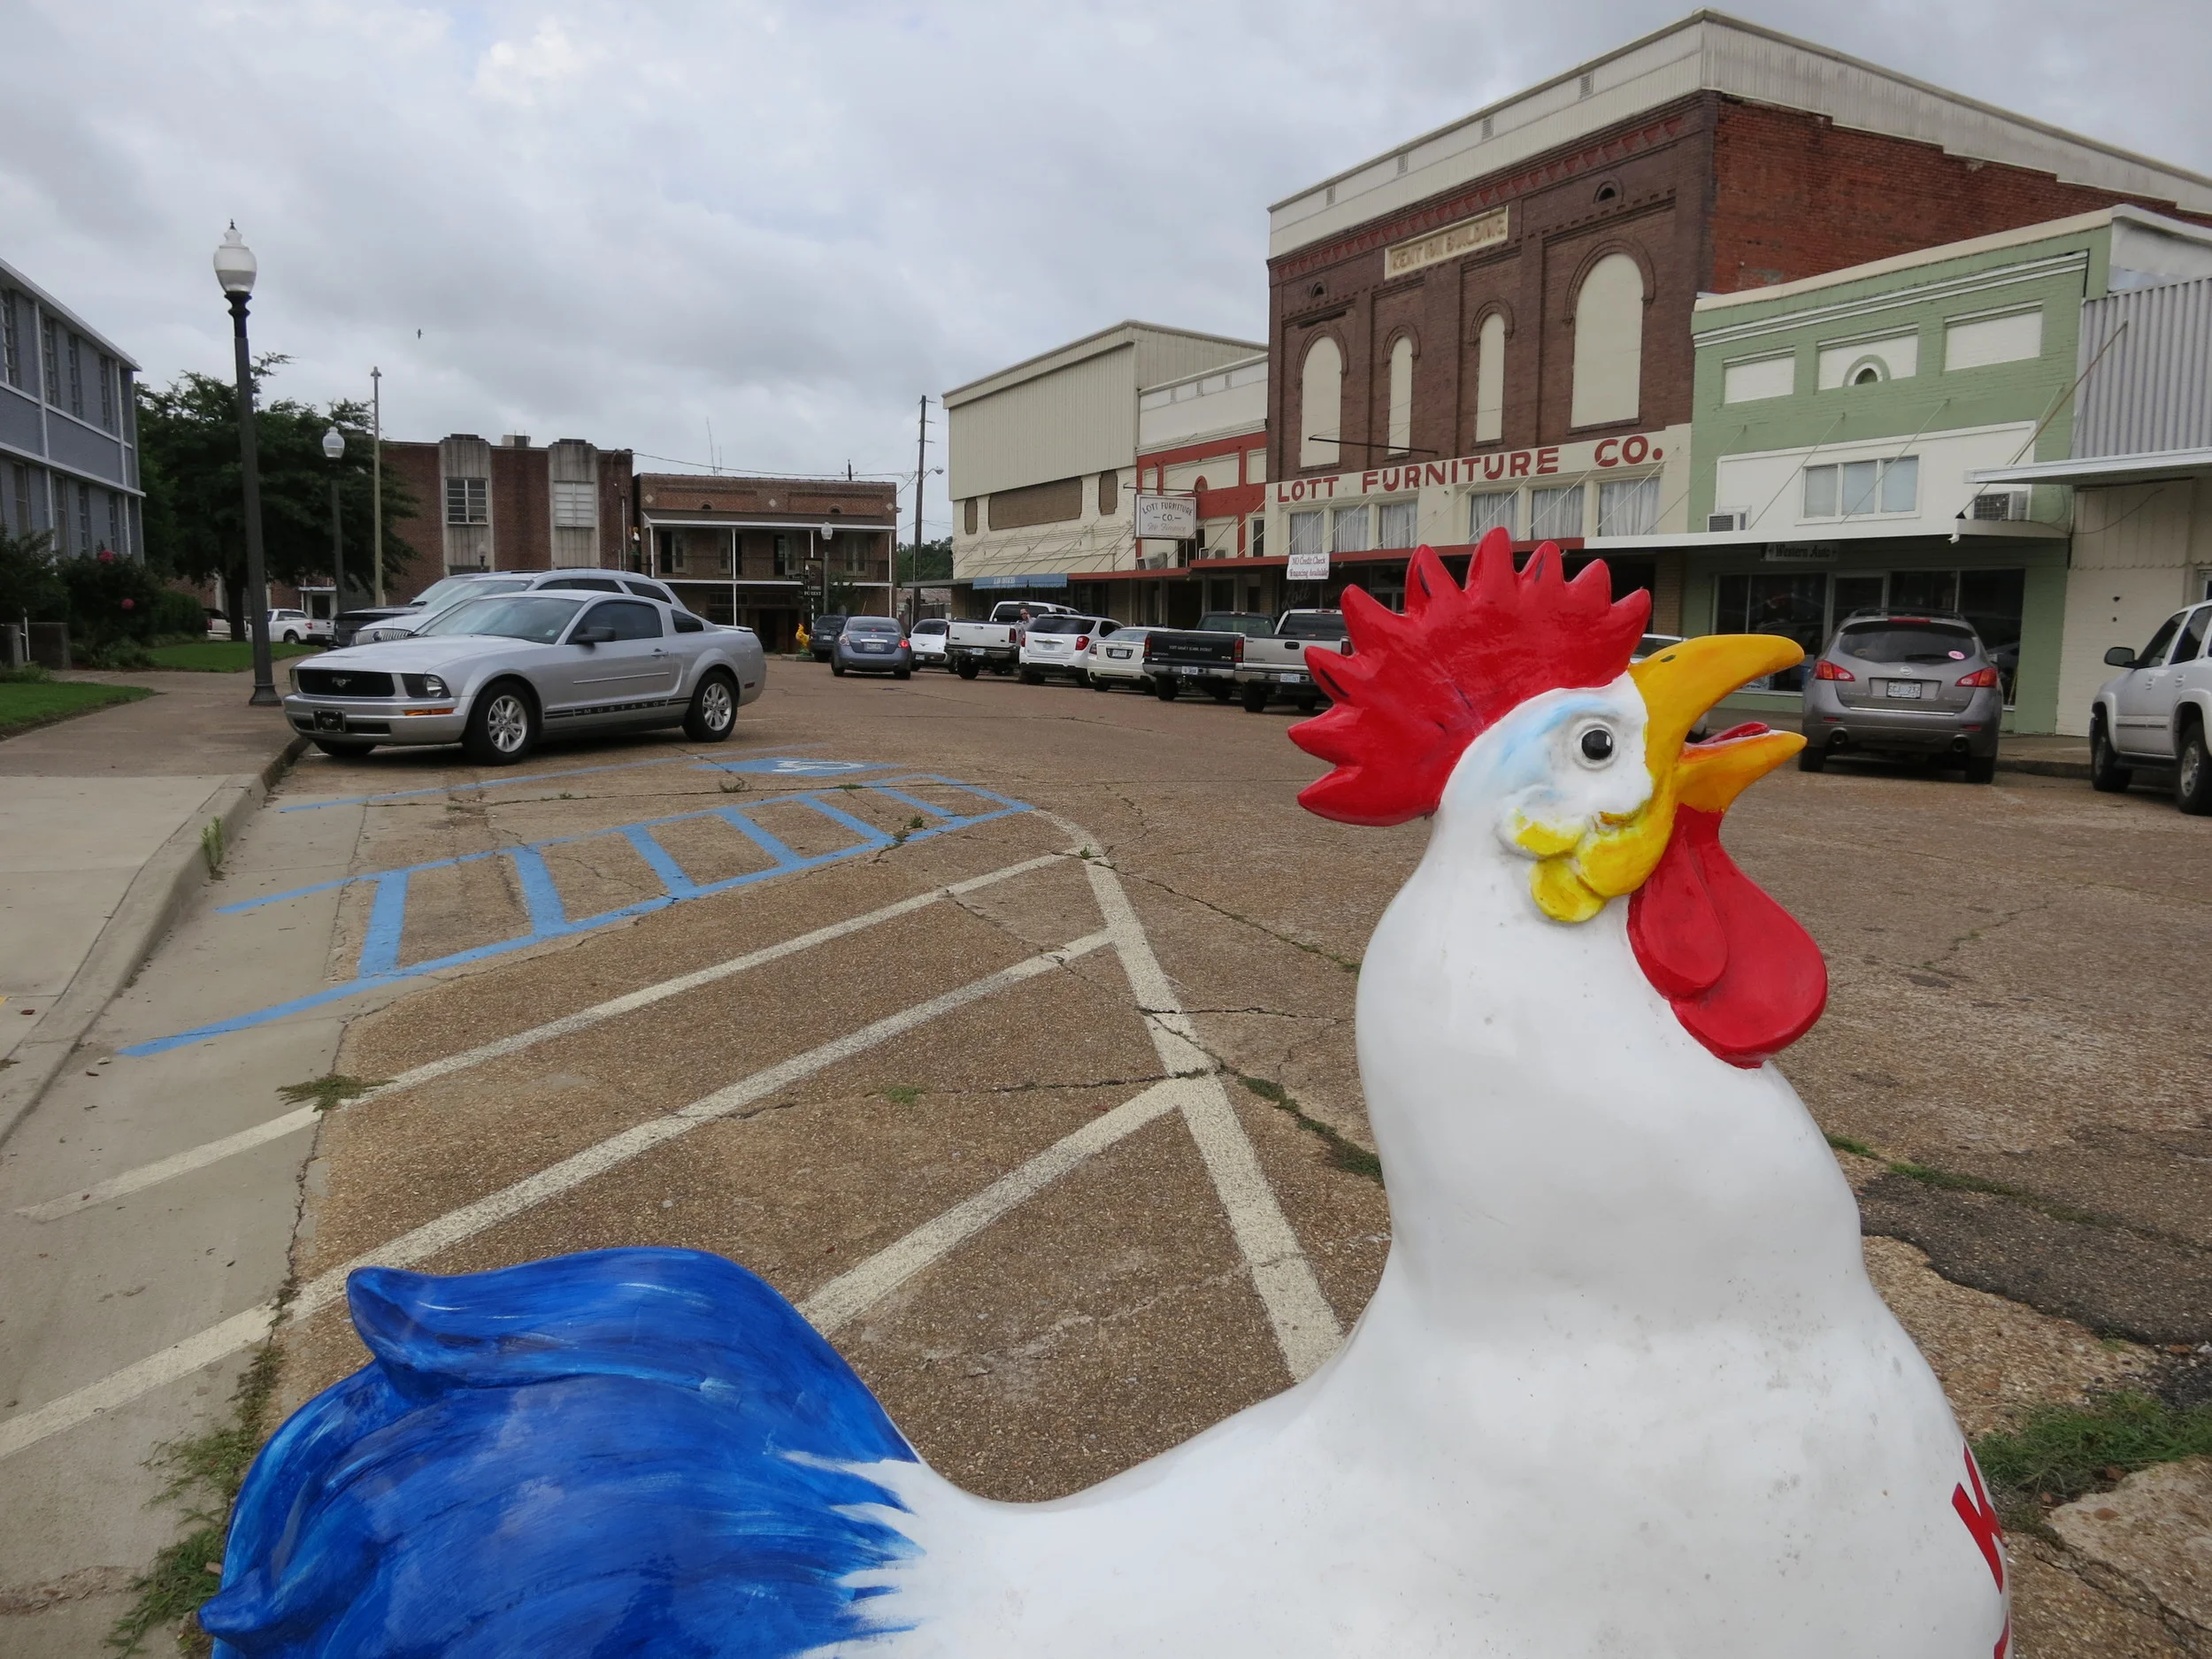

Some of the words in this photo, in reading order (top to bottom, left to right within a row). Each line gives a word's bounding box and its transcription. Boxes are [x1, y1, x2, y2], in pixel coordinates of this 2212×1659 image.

[1446, 215, 1506, 252] BUILDING
[1278, 476, 1340, 503] LOTT
[1362, 447, 1559, 495] FURNITURE
[1594, 435, 1663, 467] CO.
[1142, 503, 1158, 514] LOTT
[1161, 502, 1193, 516] FURNITURE
[1162, 513, 1174, 522] CO.
[1776, 543, 1808, 557] Western
[1809, 544, 1830, 557] Auto
[584, 702, 659, 714] MUSTANG
